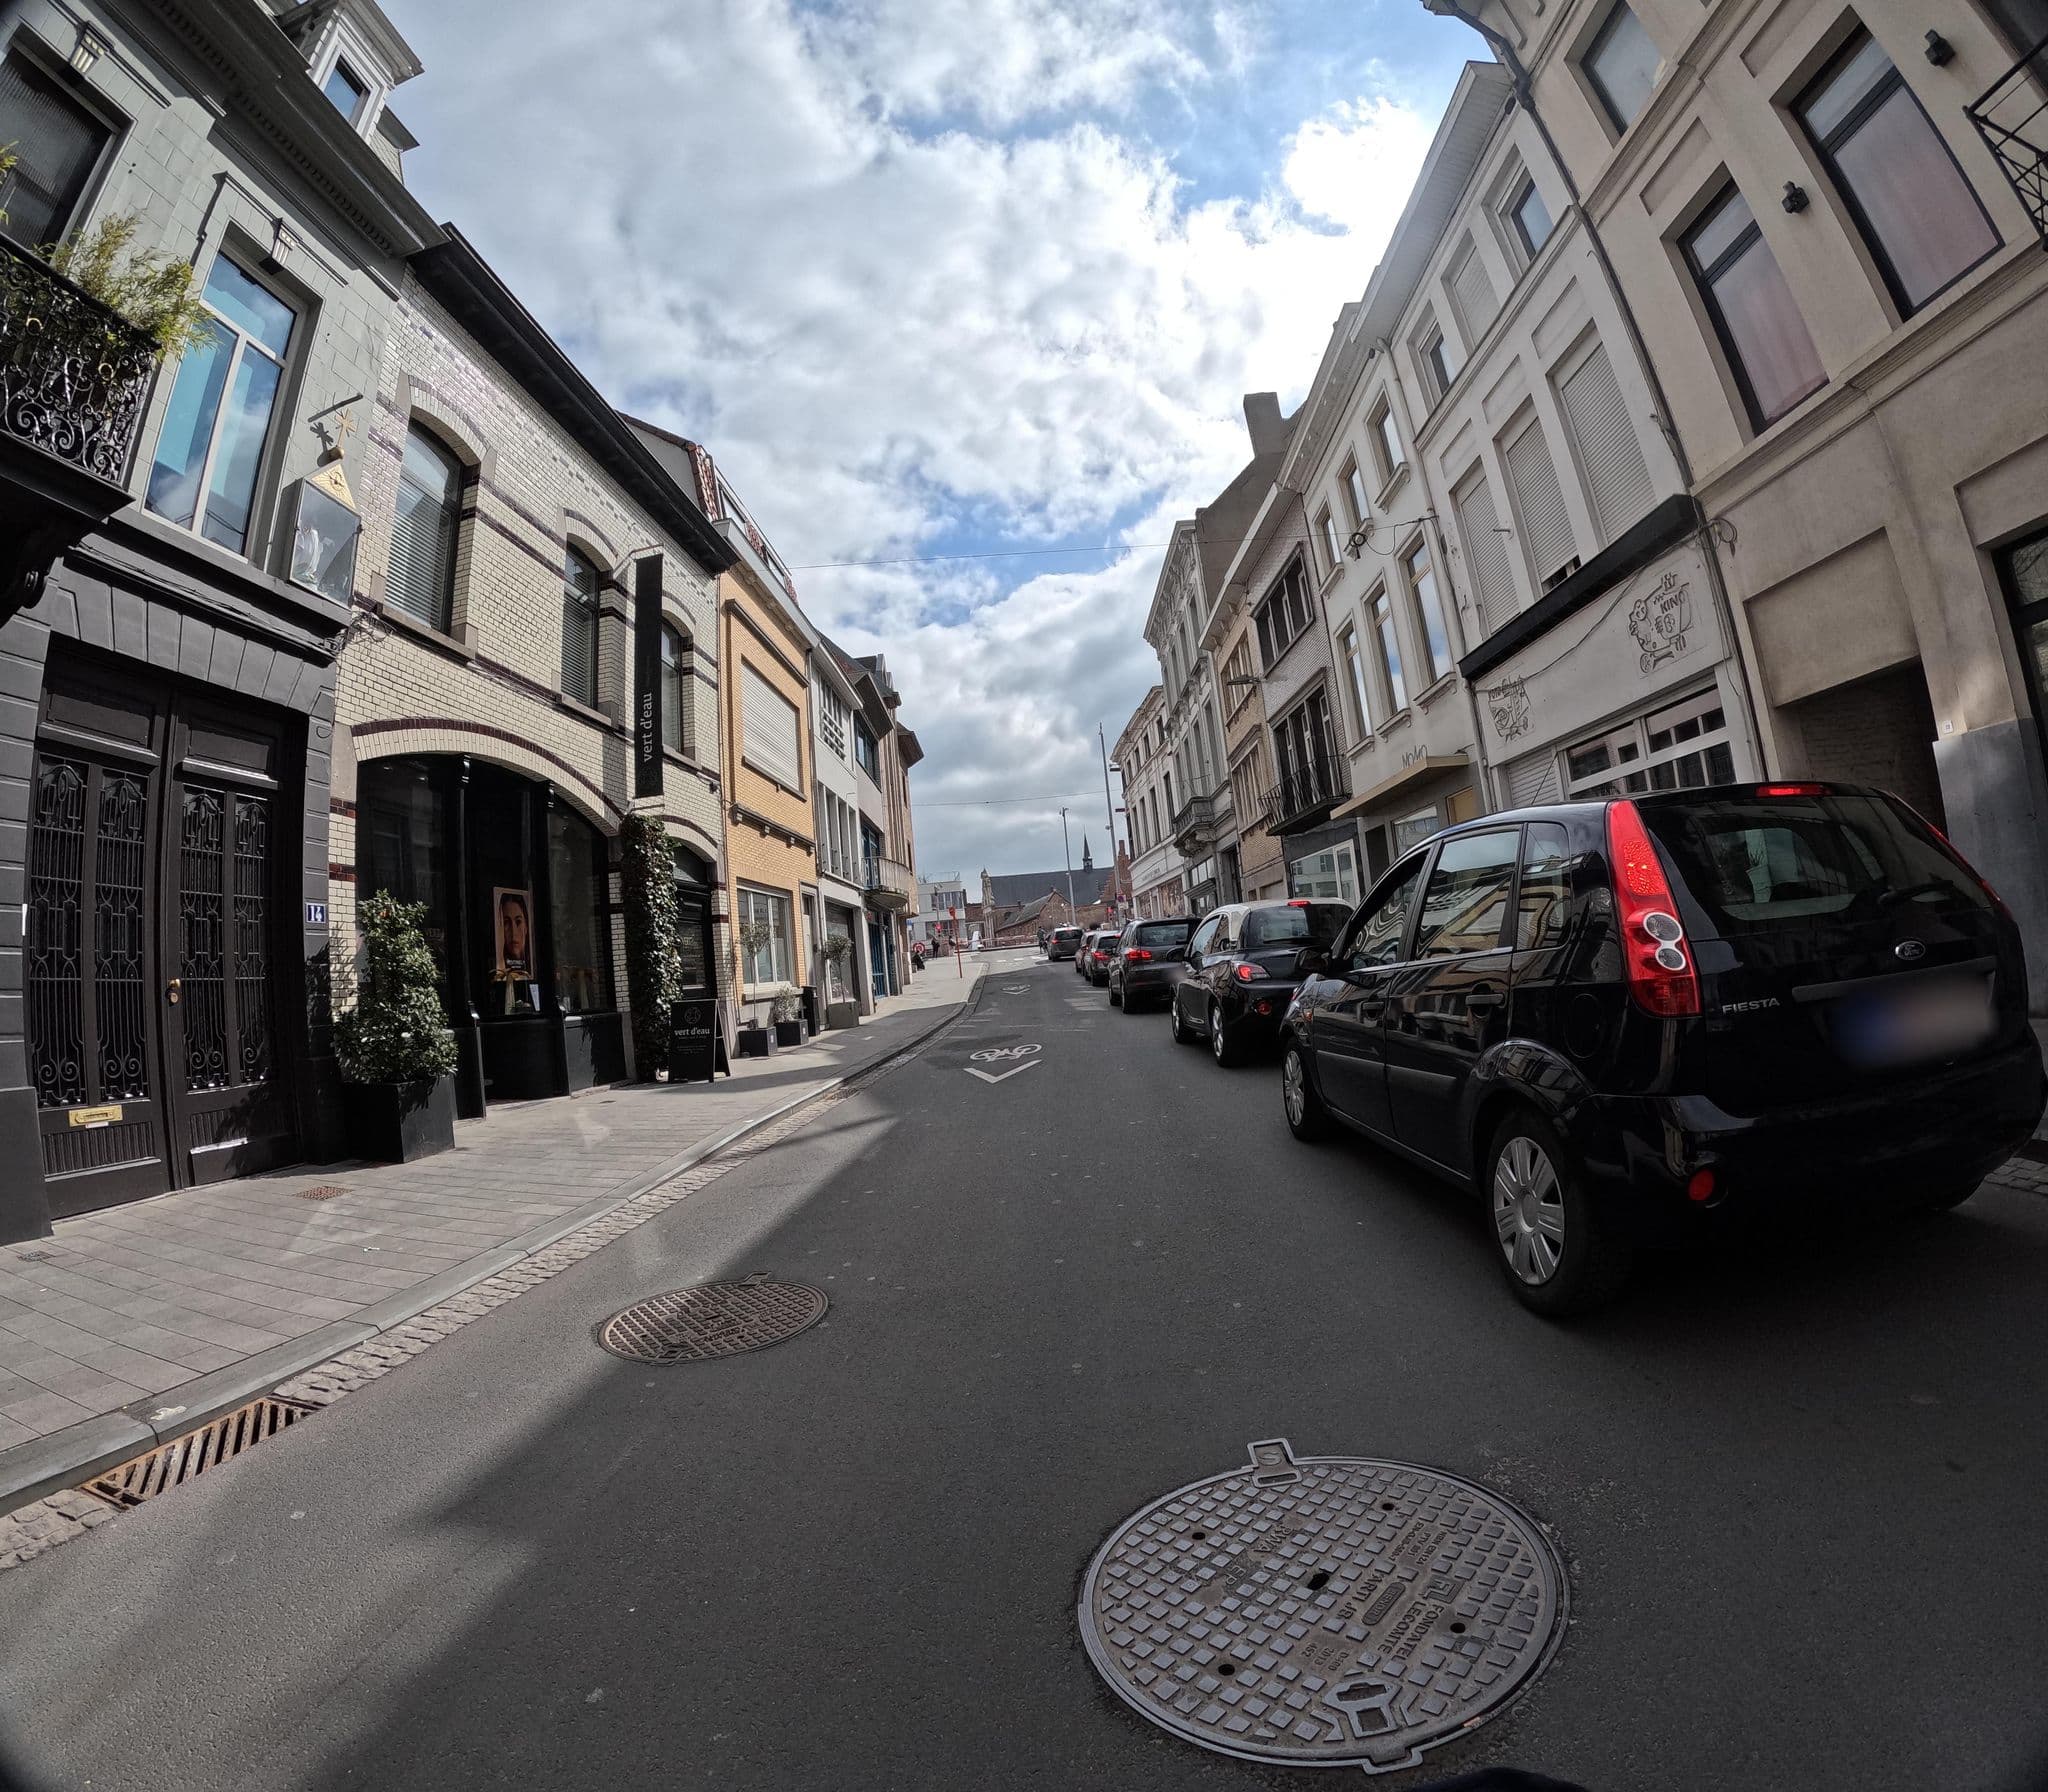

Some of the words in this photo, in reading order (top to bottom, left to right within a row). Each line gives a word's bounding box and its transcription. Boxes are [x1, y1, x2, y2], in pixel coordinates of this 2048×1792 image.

[639, 692, 653, 732] d'eau
[642, 733, 653, 762] vert
[1722, 997, 1780, 1015] FIESTA
[674, 1028, 690, 1036] vert
[690, 1027, 711, 1036] d'eau
[1377, 1601, 1427, 1654] LECOMTE
[1391, 1604, 1444, 1661] FONDATEL
[1314, 1647, 1335, 1665] 2013
